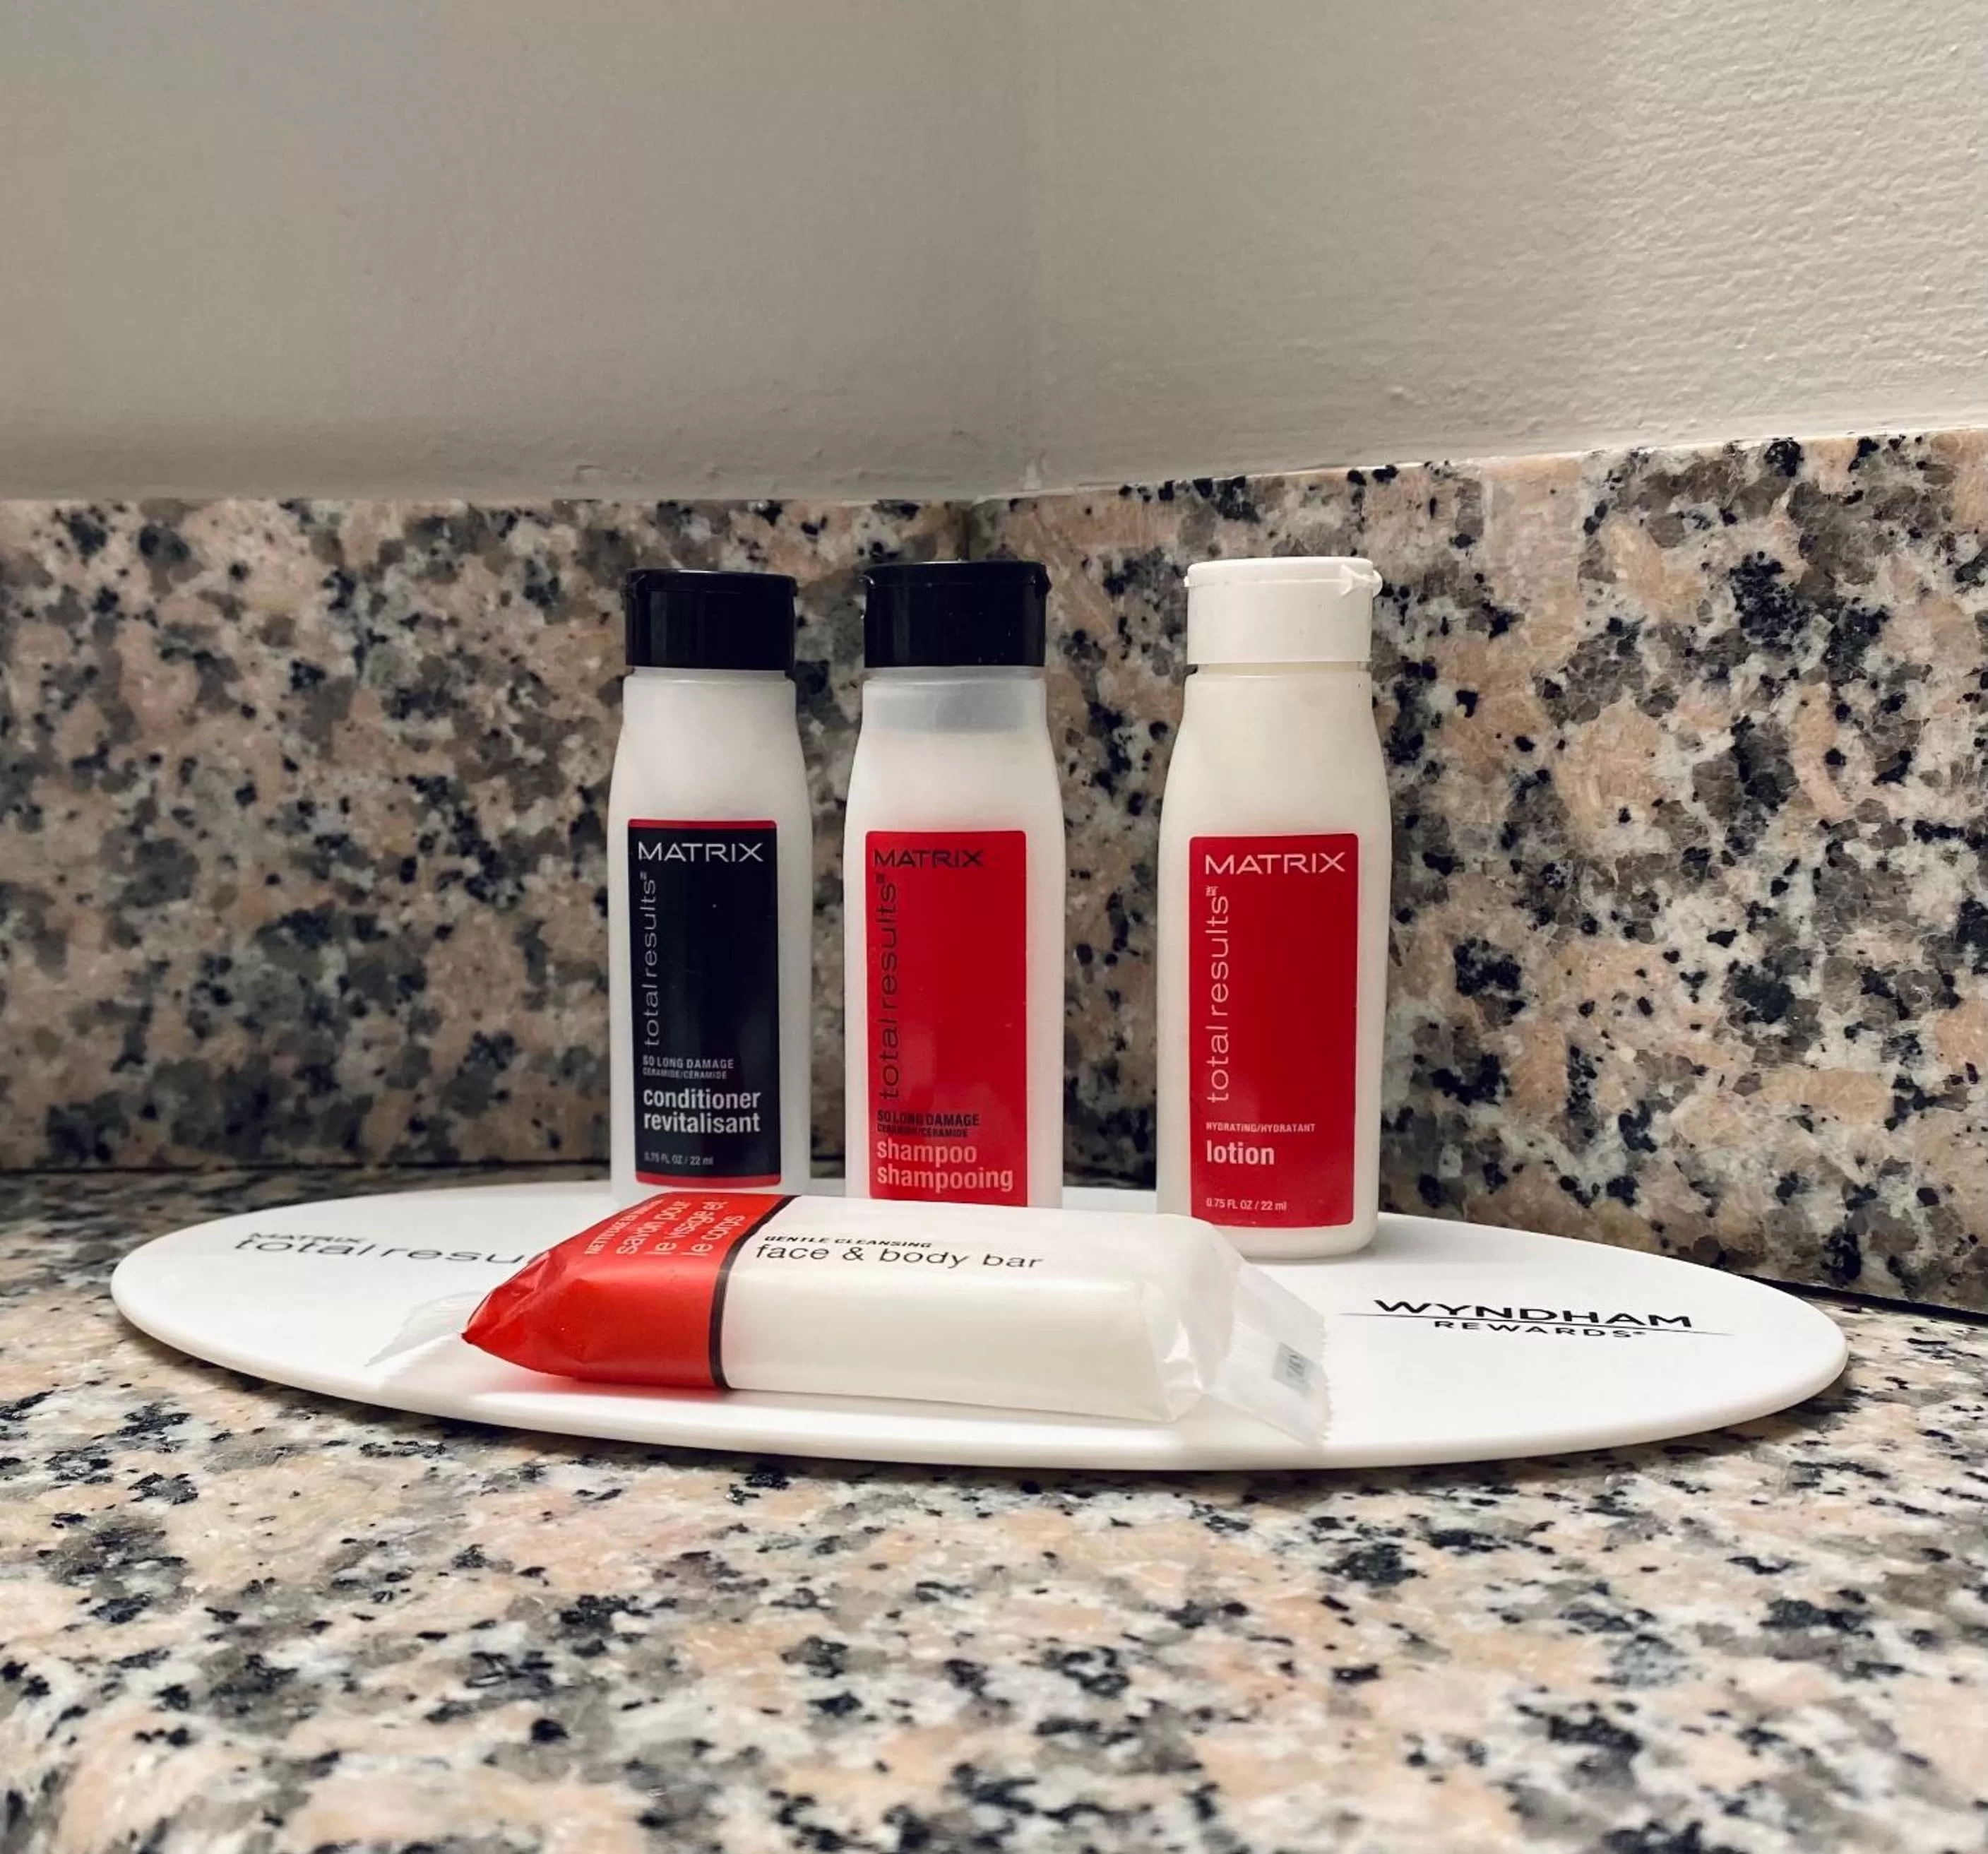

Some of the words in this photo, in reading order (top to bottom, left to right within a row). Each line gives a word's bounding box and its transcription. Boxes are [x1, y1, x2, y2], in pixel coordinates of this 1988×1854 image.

[638, 841, 764, 862] MATRIX
[874, 849, 984, 868] MATRIX
[1205, 852, 1346, 874] MATRIX
[643, 1055, 654, 1066] SO
[657, 1057, 683, 1069] LONG
[686, 1059, 734, 1069] DAMAGE
[643, 1088, 761, 1110] conditioner
[643, 1112, 761, 1134] revitalisant
[877, 1110, 891, 1122] SO
[926, 1113, 980, 1127] DAMAGE
[1206, 1122, 1316, 1133] HYDRATING/HYDRATANT
[690, 1155, 701, 1165] 22
[876, 1137, 977, 1167] shampoo
[1206, 1140, 1275, 1165] lotion
[877, 1163, 1013, 1193] shampooing
[1206, 1198, 1225, 1209] 0.75
[1227, 1199, 1238, 1210] FL
[1240, 1199, 1252, 1211] OZ
[1261, 1200, 1273, 1211] 22
[1275, 1201, 1287, 1211] ml
[249, 1232, 366, 1243] MATRIX
[615, 1221, 667, 1254] savon
[653, 1201, 692, 1220] pour
[680, 1243, 713, 1256] le
[701, 1215, 746, 1240] corps
[643, 1242, 678, 1255] le
[764, 1235, 826, 1244] GENTLE
[834, 1238, 933, 1248] CLEANSING
[381, 1247, 524, 1264] resu
[755, 1244, 830, 1260] face
[842, 1247, 864, 1261] &
[879, 1249, 969, 1268] body
[982, 1254, 1044, 1268] bar
[1374, 1300, 1692, 1328] WYNDHAM
